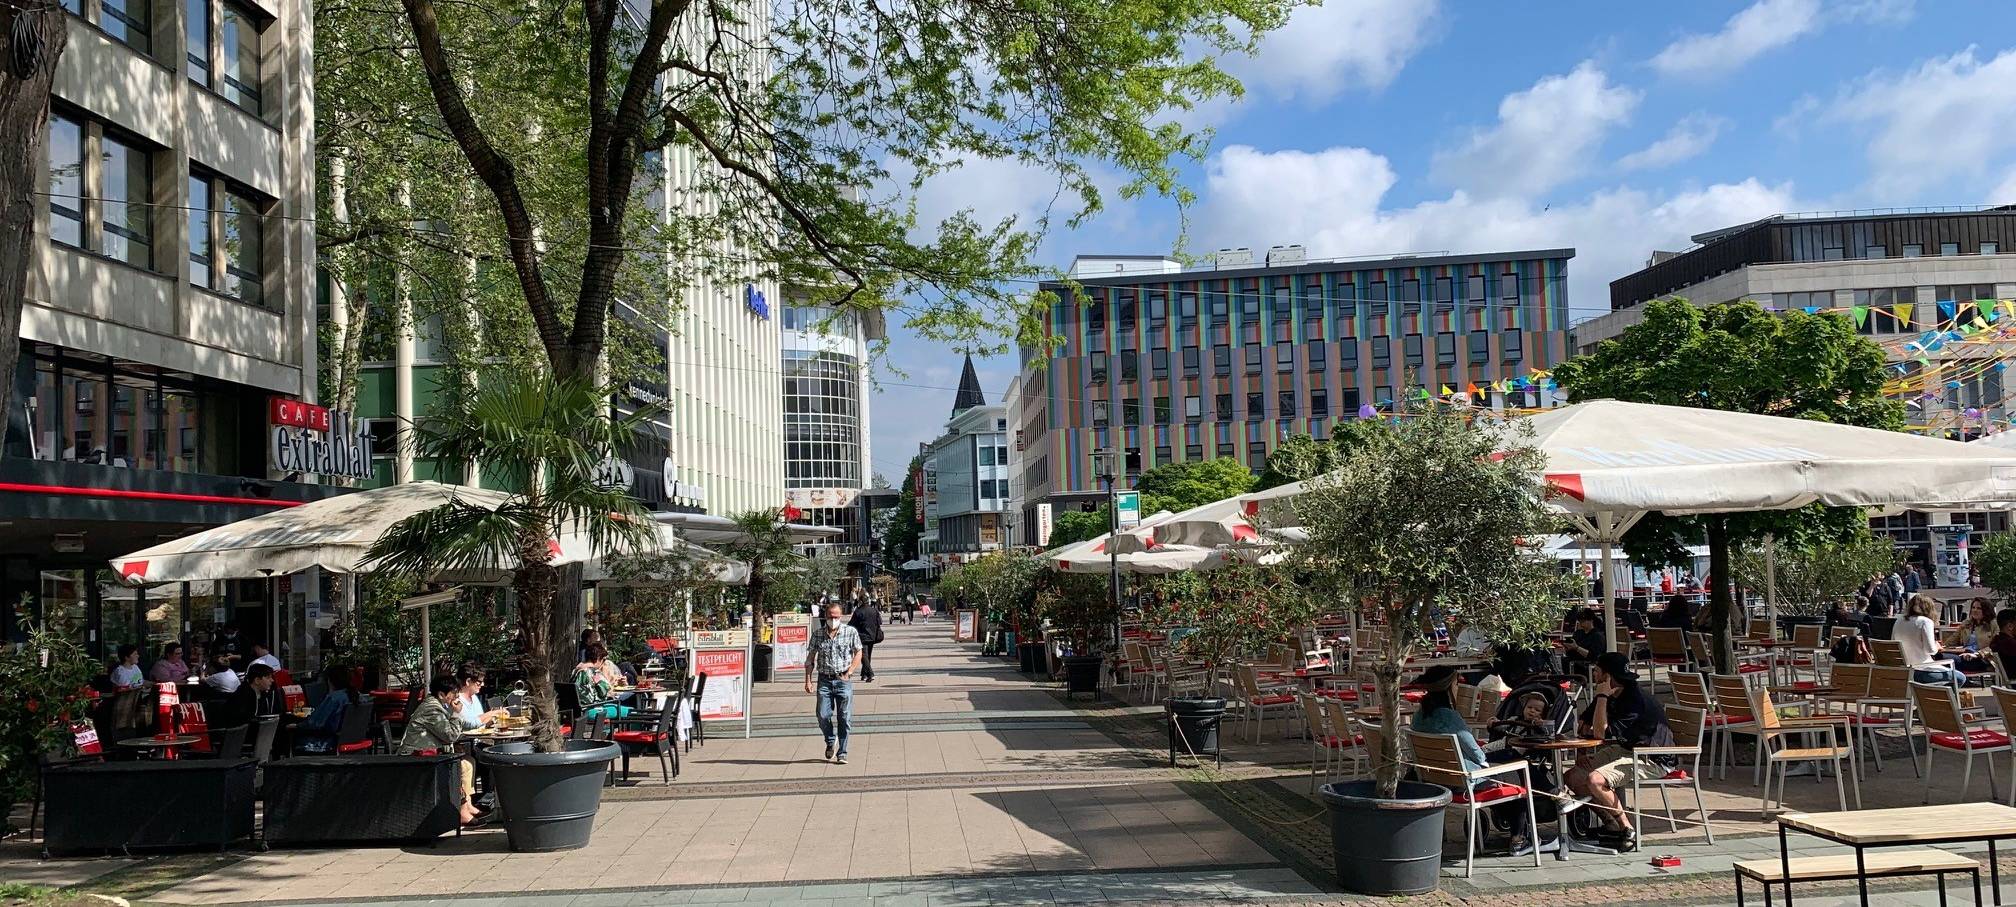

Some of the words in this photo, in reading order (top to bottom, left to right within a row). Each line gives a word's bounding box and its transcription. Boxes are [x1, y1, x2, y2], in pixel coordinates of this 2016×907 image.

[279, 404, 328, 426] CAFE
[277, 409, 378, 480] extrablatt
[698, 651, 743, 665] TESTPFLICHT
